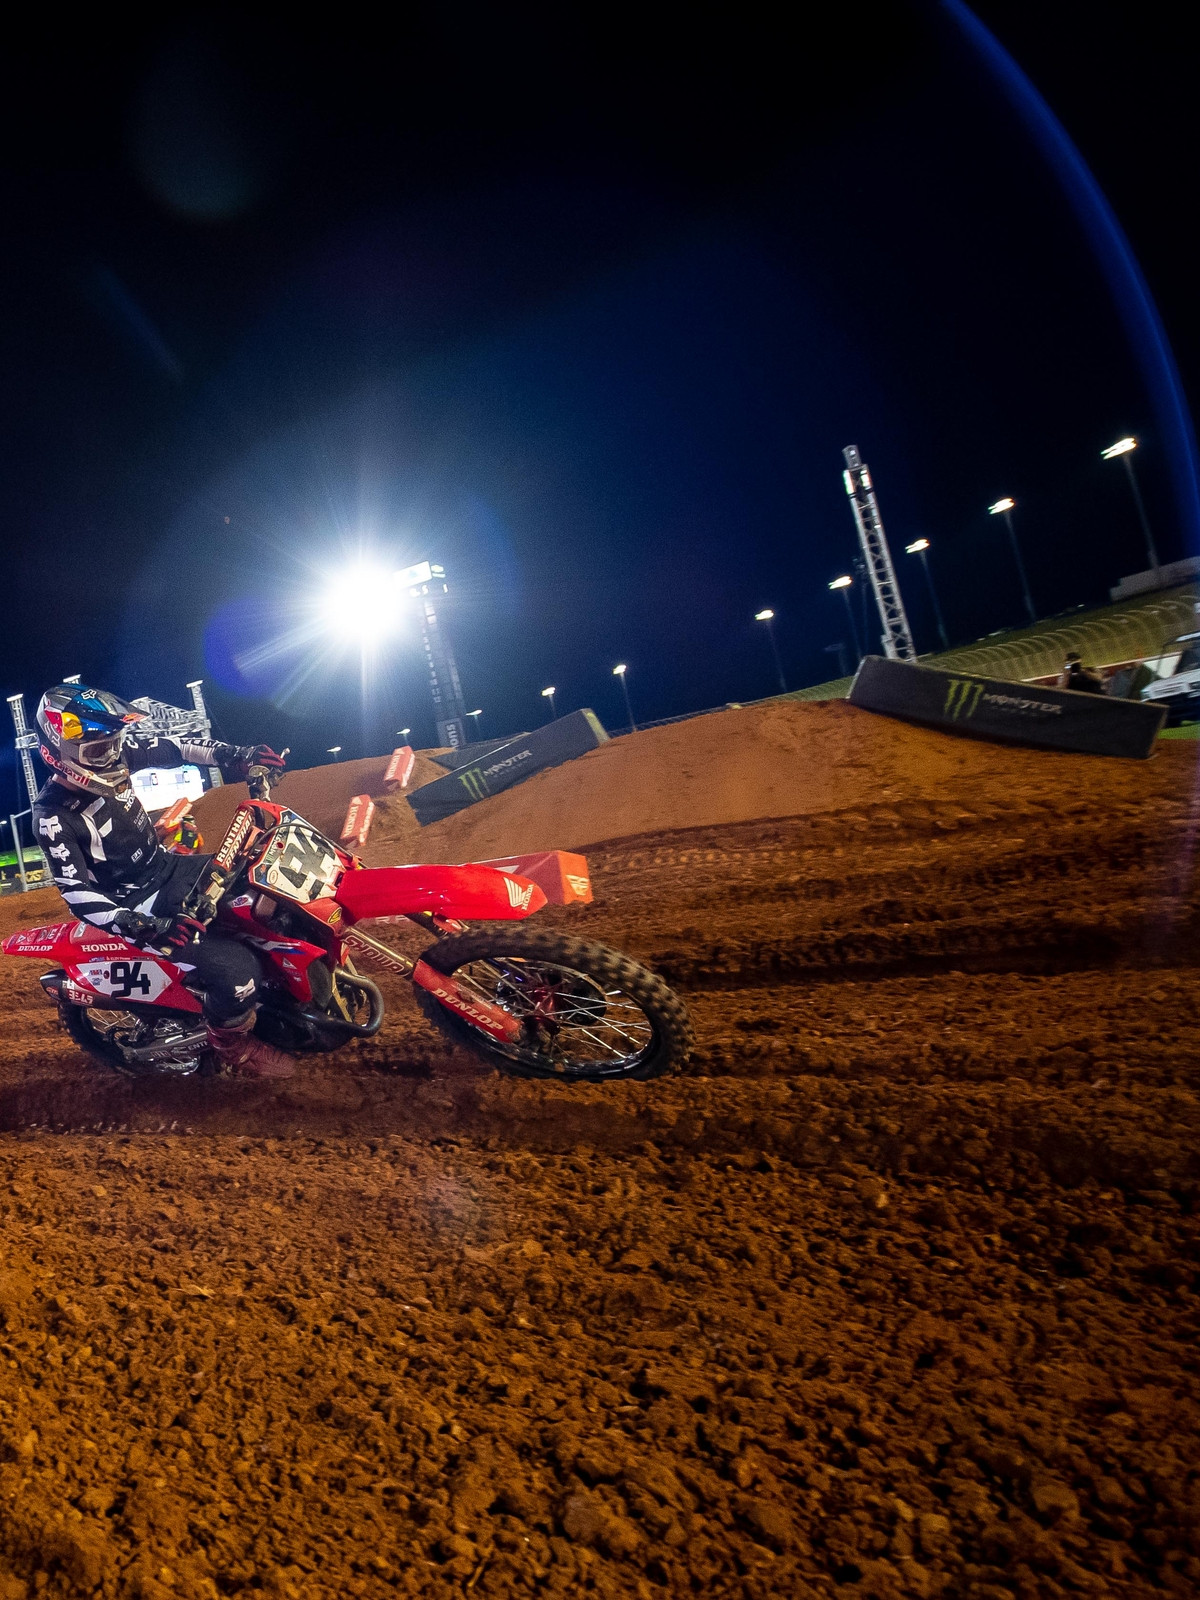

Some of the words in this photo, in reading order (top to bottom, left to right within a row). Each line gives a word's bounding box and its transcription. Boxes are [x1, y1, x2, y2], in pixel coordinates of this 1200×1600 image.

[216, 810, 247, 863] RENTHAL
[342, 805, 359, 838] HONDA
[521, 884, 535, 911] HONDA
[81, 943, 128, 952] HONDA
[341, 935, 405, 974] SHOWA
[110, 961, 151, 999] 94
[431, 987, 504, 1030] DUNLOP
